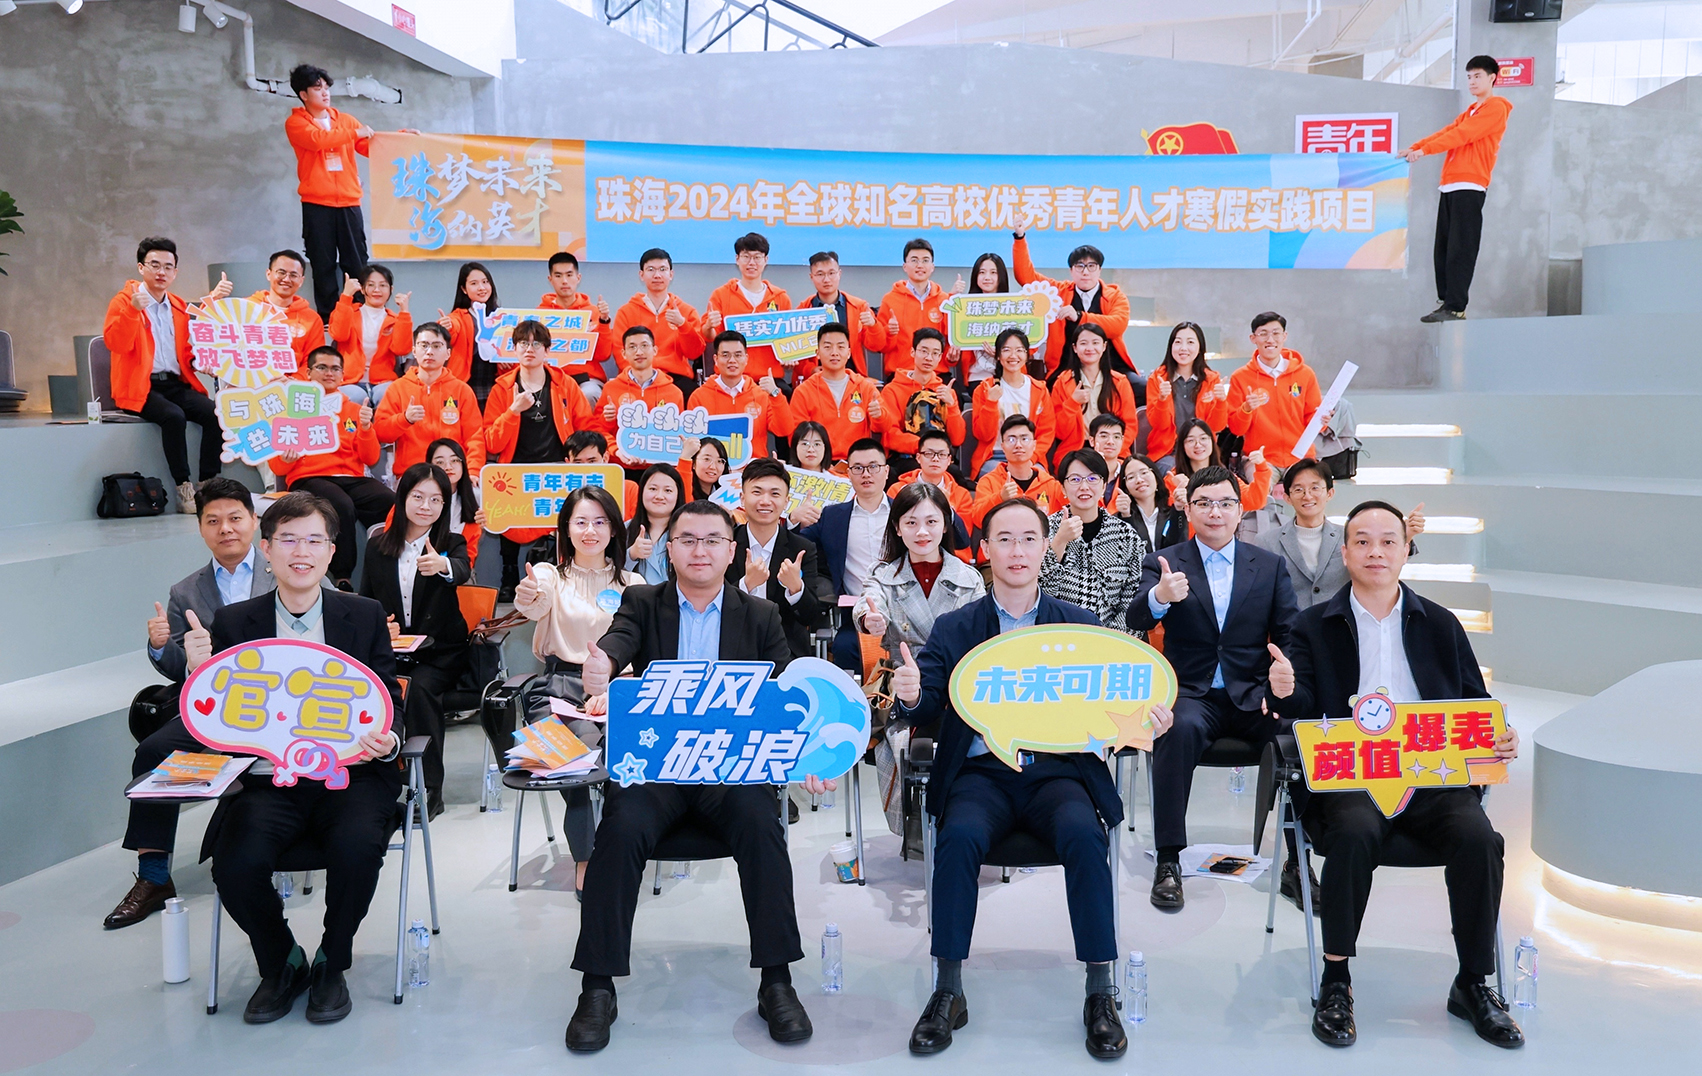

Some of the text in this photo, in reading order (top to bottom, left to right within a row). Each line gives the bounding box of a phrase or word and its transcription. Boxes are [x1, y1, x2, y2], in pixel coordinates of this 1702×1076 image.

[391, 151, 563, 206] 珠梦未来
[409, 198, 550, 250] 海纳英才
[596, 178, 1374, 231] 珠海2024年全球知名高校优秀青年人才寒假实践项目
[734, 314, 827, 336] 凭实力优秀
[966, 299, 1034, 316] 珠梦未来
[192, 323, 290, 346] 奋斗青春
[197, 348, 295, 370] 放飞梦想
[229, 391, 316, 420] 与珠海
[246, 424, 330, 452] 共未来
[211, 646, 371, 742] 官宣
[628, 662, 772, 716] 乘风
[972, 663, 1153, 704] 未来可期
[658, 729, 808, 782] 破浪
